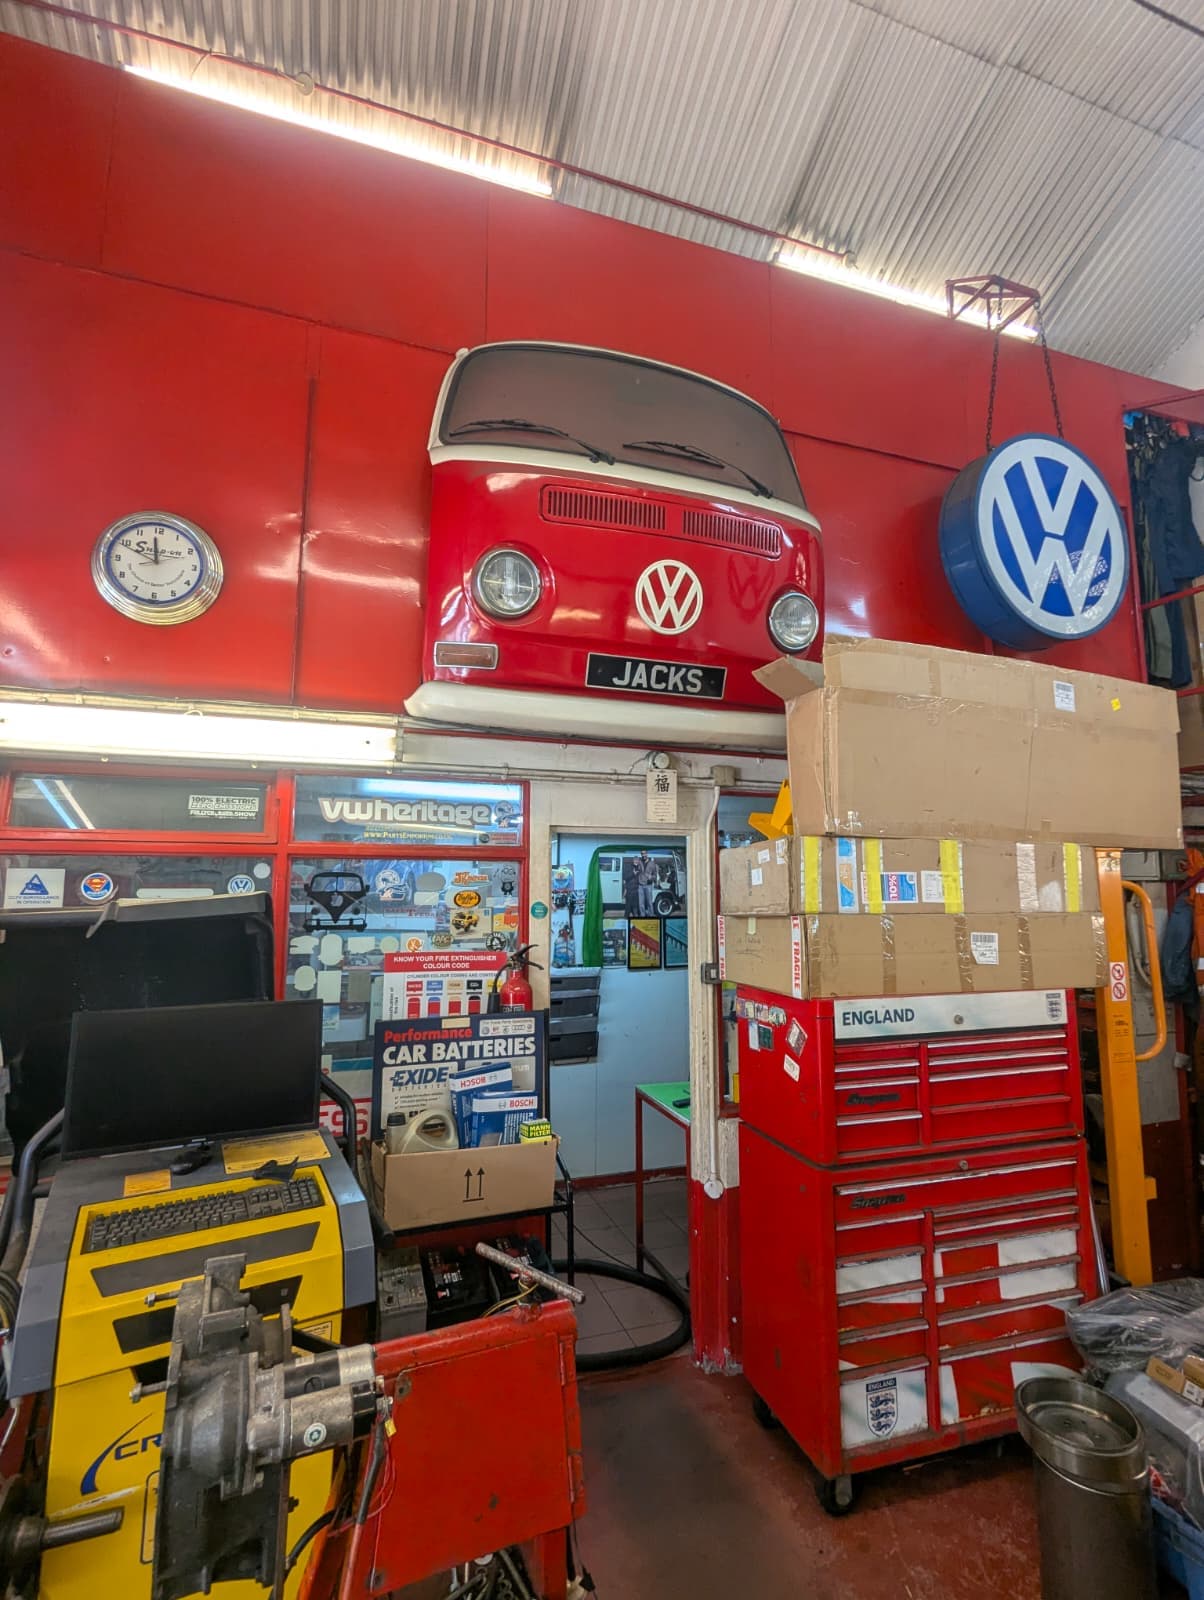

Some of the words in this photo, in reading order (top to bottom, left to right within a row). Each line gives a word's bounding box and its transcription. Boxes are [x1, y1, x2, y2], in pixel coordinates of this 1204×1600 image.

[154, 527, 164, 535] 12
[191, 564, 197, 572] 3
[634, 559, 703, 635] VW
[612, 661, 703, 693] JACKS
[654, 774, 670, 793] 福
[215, 797, 257, 805] ELECTRIC
[319, 798, 491, 826] vwheritage
[793, 942, 801, 989] FRAGILE
[842, 1008, 915, 1026] ENGLAND
[383, 1027, 473, 1043] Performance
[382, 1044, 427, 1065] CAR
[432, 1036, 536, 1062] BATTERIES
[390, 1066, 449, 1087] EXIDE
[460, 1077, 487, 1089] BOSCH
[509, 1099, 534, 1108] BOSCH
[529, 1123, 551, 1131] MANN
[867, 1379, 896, 1392] ENGLAND
